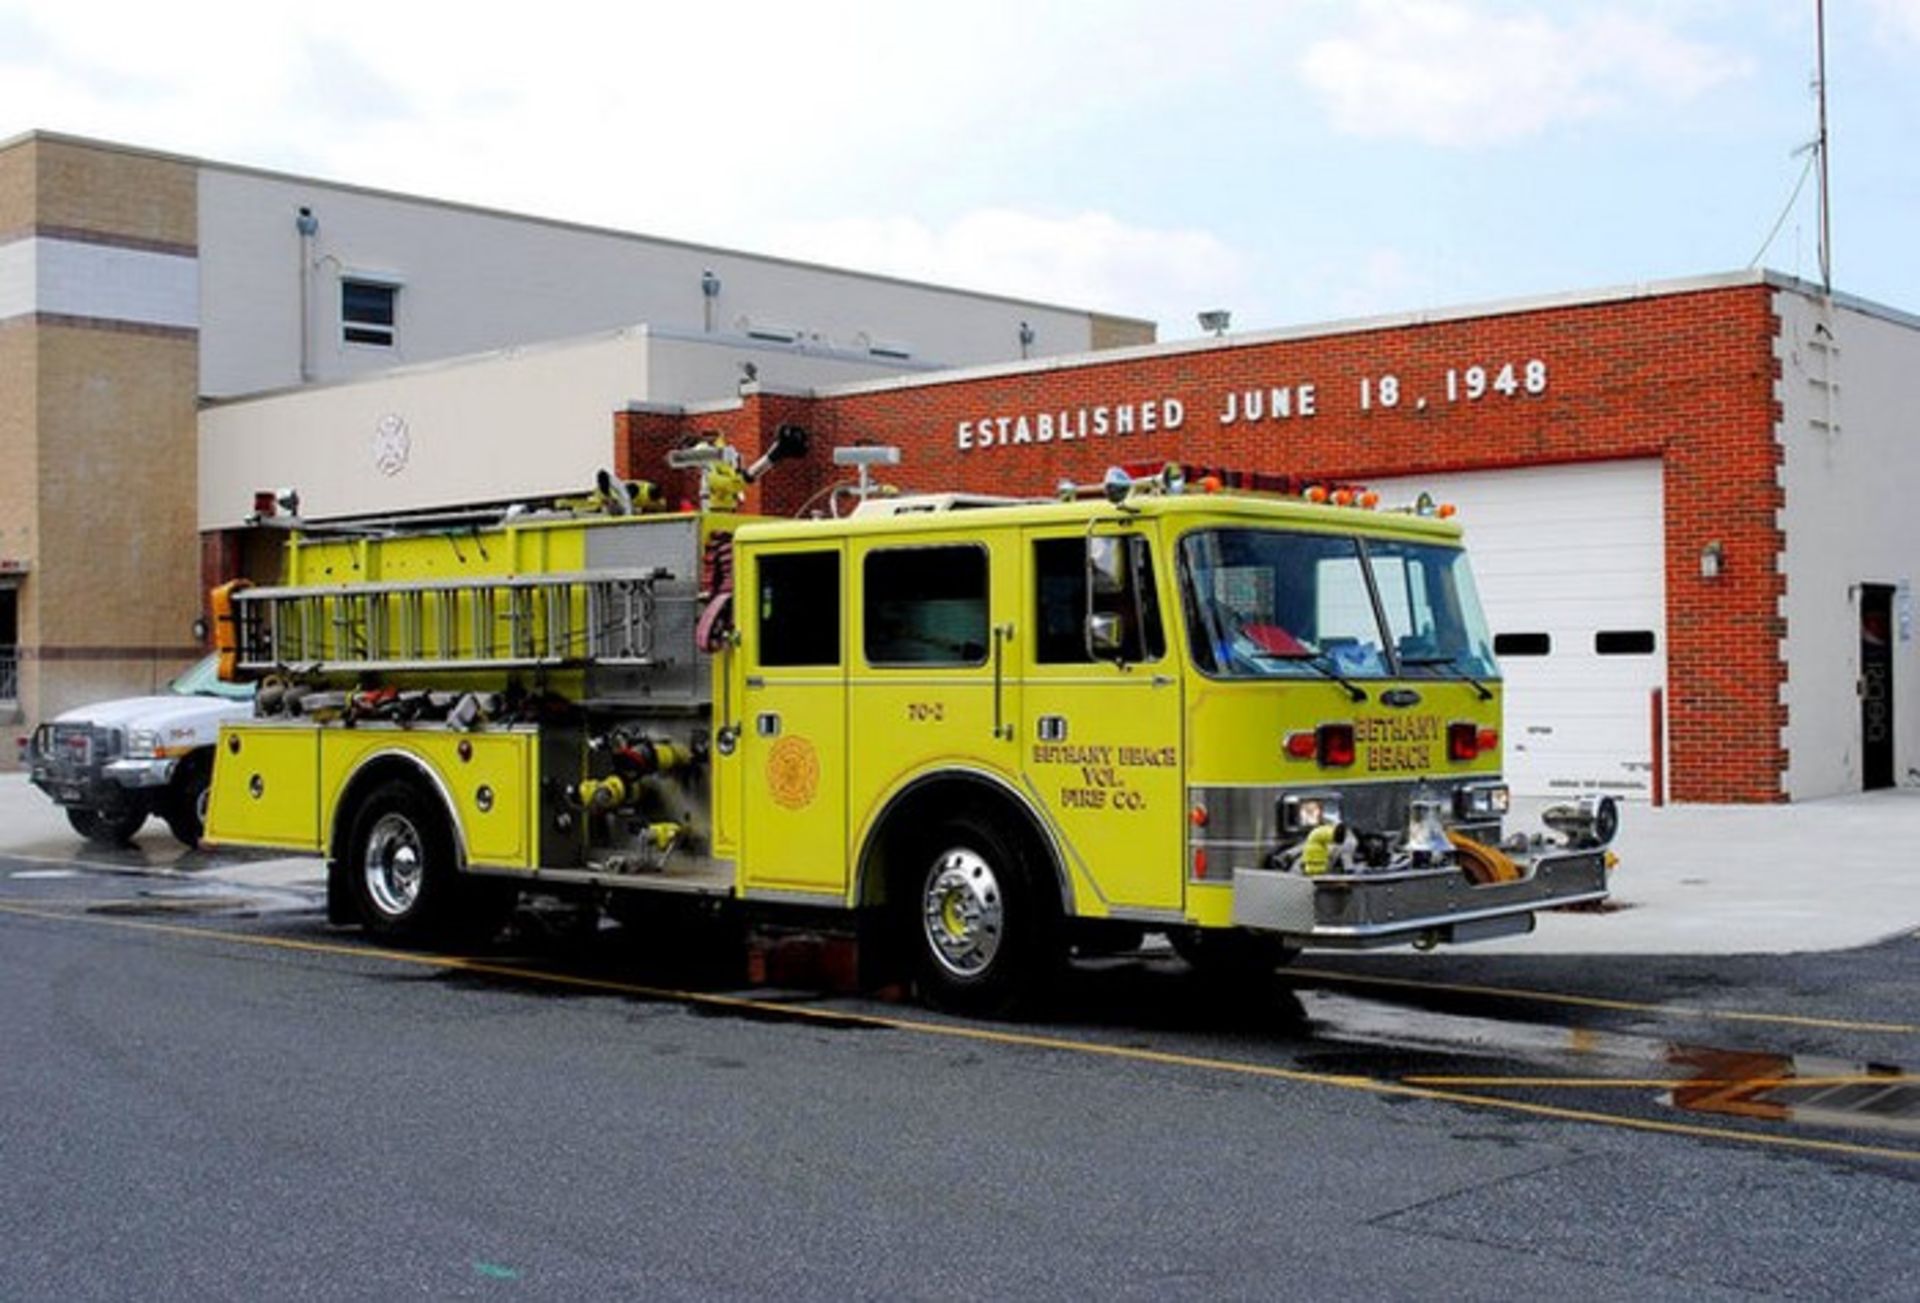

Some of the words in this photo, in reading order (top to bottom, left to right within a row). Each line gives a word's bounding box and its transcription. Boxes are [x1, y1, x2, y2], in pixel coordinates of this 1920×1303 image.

[957, 399, 1185, 449] ESTABLISHED
[1219, 385, 1317, 425] JUNE
[1446, 359, 1548, 401] 1948
[1354, 713, 1440, 742] BETHANY
[1033, 745, 1114, 764] BETHANY
[1118, 747, 1177, 766] BEACH
[1367, 744, 1430, 771] BEACH
[1082, 767, 1124, 787] VOL.
[1061, 787, 1108, 809] FIRE
[1112, 790, 1147, 811] CO.
